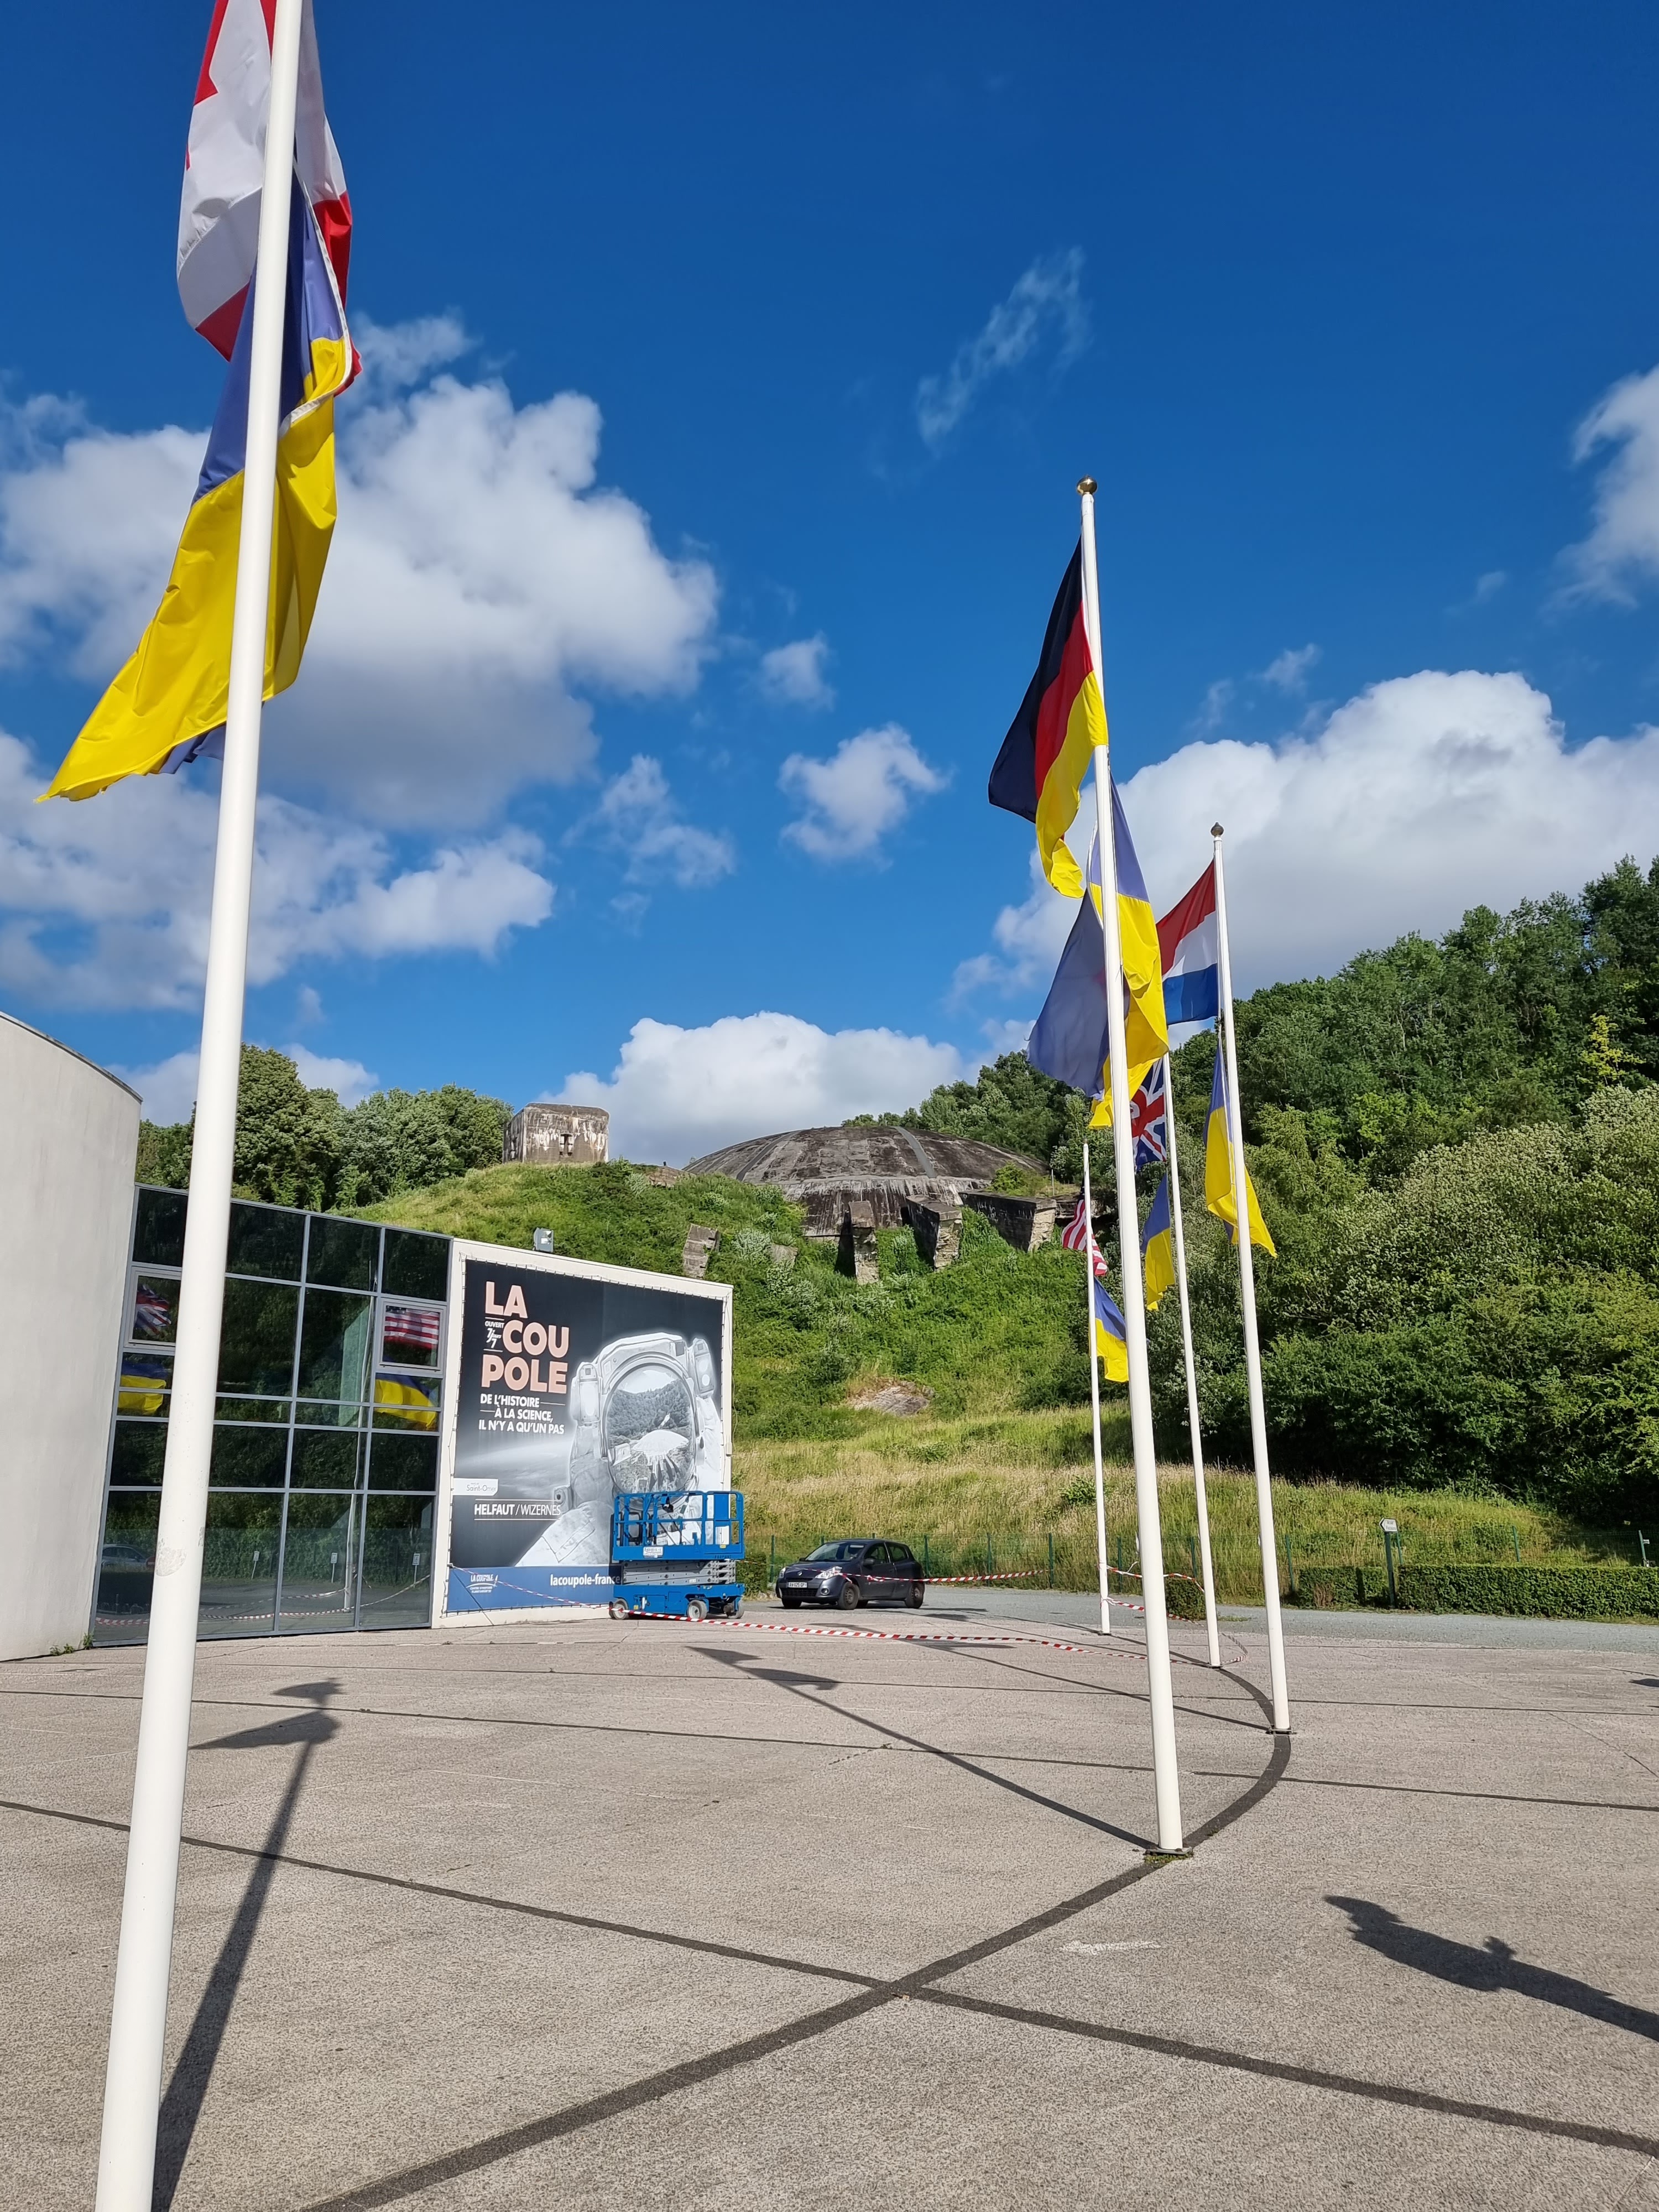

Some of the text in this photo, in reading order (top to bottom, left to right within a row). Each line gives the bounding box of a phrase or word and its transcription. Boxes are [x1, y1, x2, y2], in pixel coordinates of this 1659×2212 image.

[486, 1281, 528, 1319] LA
[485, 1321, 505, 1329] OUVERT
[503, 1319, 570, 1358] COU
[481, 1354, 568, 1394] POLE
[480, 1393, 540, 1408] DE L'HISTOIRE
[494, 1405, 554, 1423] À LA SCIENCE,
[478, 1419, 565, 1435] IL N'Y A QU'UN PAS
[474, 1504, 515, 1516] HELFAUT
[520, 1504, 561, 1516] WIZERNES
